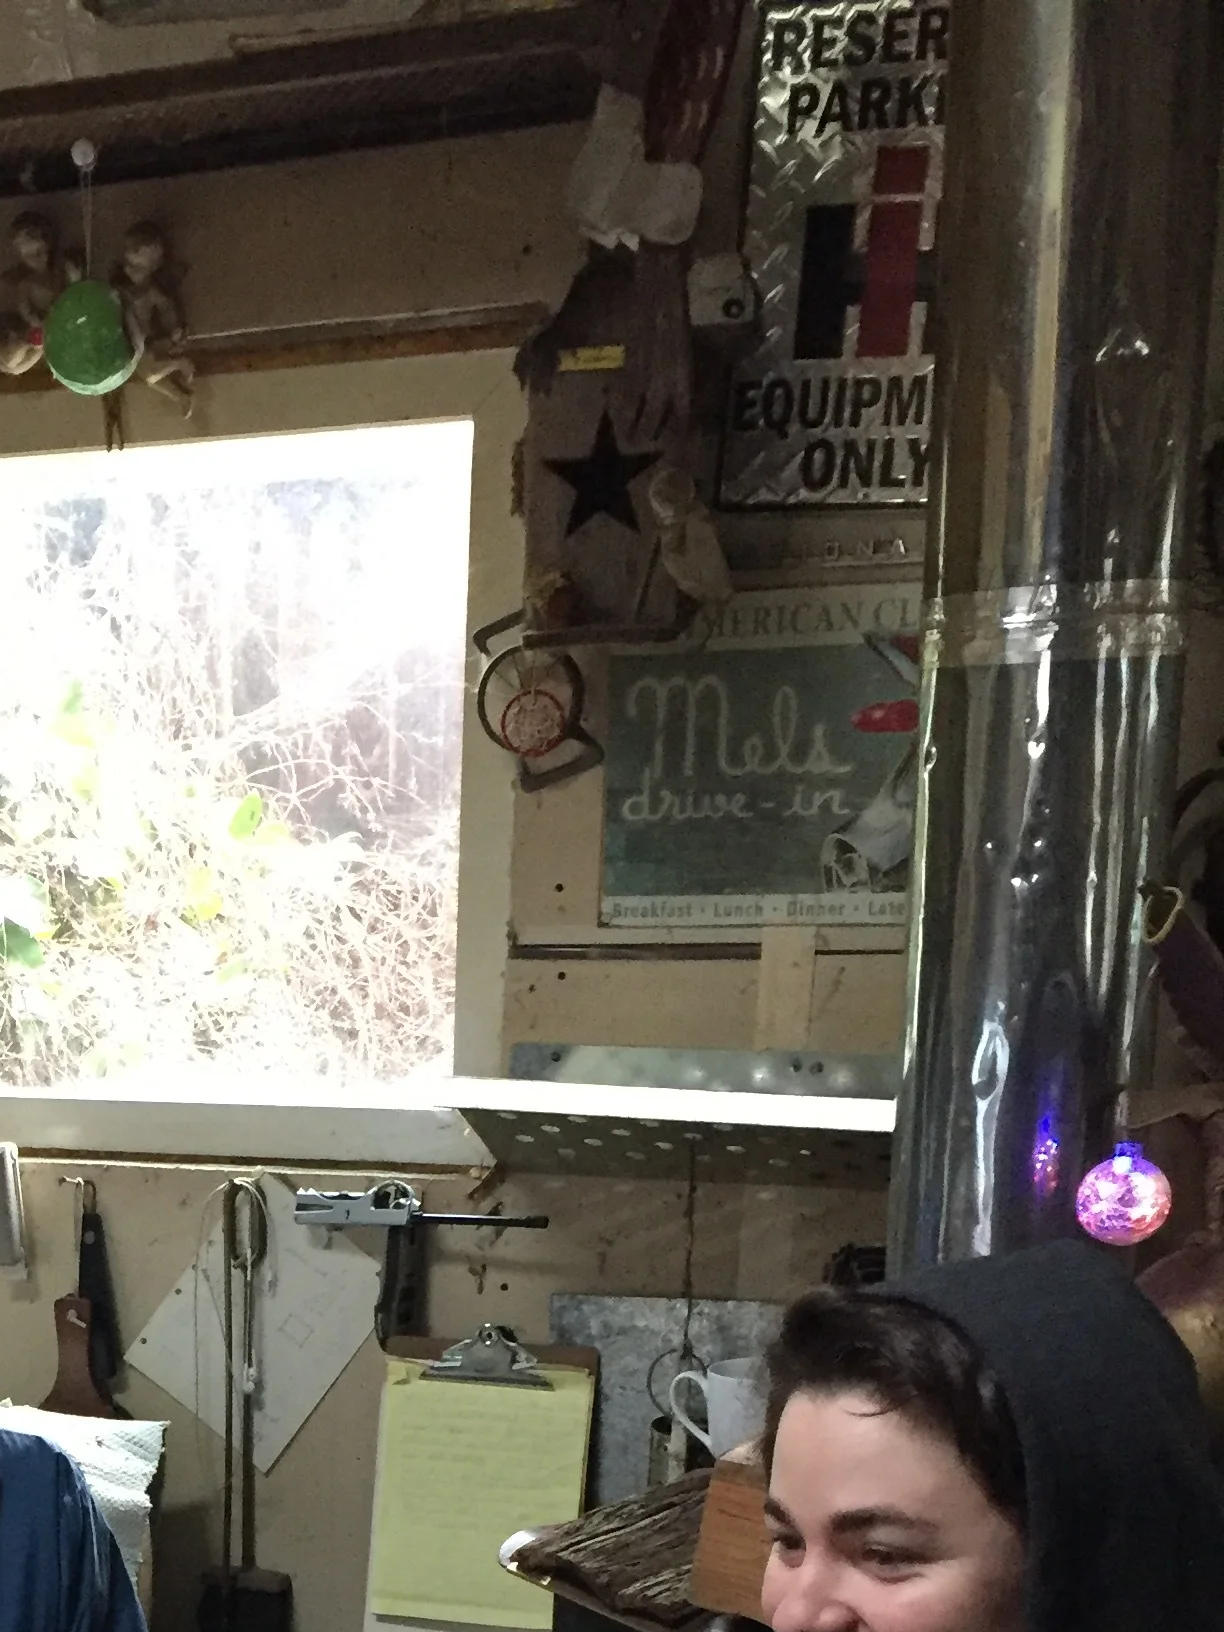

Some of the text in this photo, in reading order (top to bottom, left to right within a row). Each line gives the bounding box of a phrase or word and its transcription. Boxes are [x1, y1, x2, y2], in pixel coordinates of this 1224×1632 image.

[771, 8, 948, 74] RESER
[733, 374, 928, 439] EQUIPM
[801, 437, 929, 491] ONLY
[704, 600, 864, 638] MERICAN
[626, 676, 853, 777] Mels
[622, 767, 852, 823] drive-in
[612, 900, 906, 918] Breakfast Lunch Dinner Late
